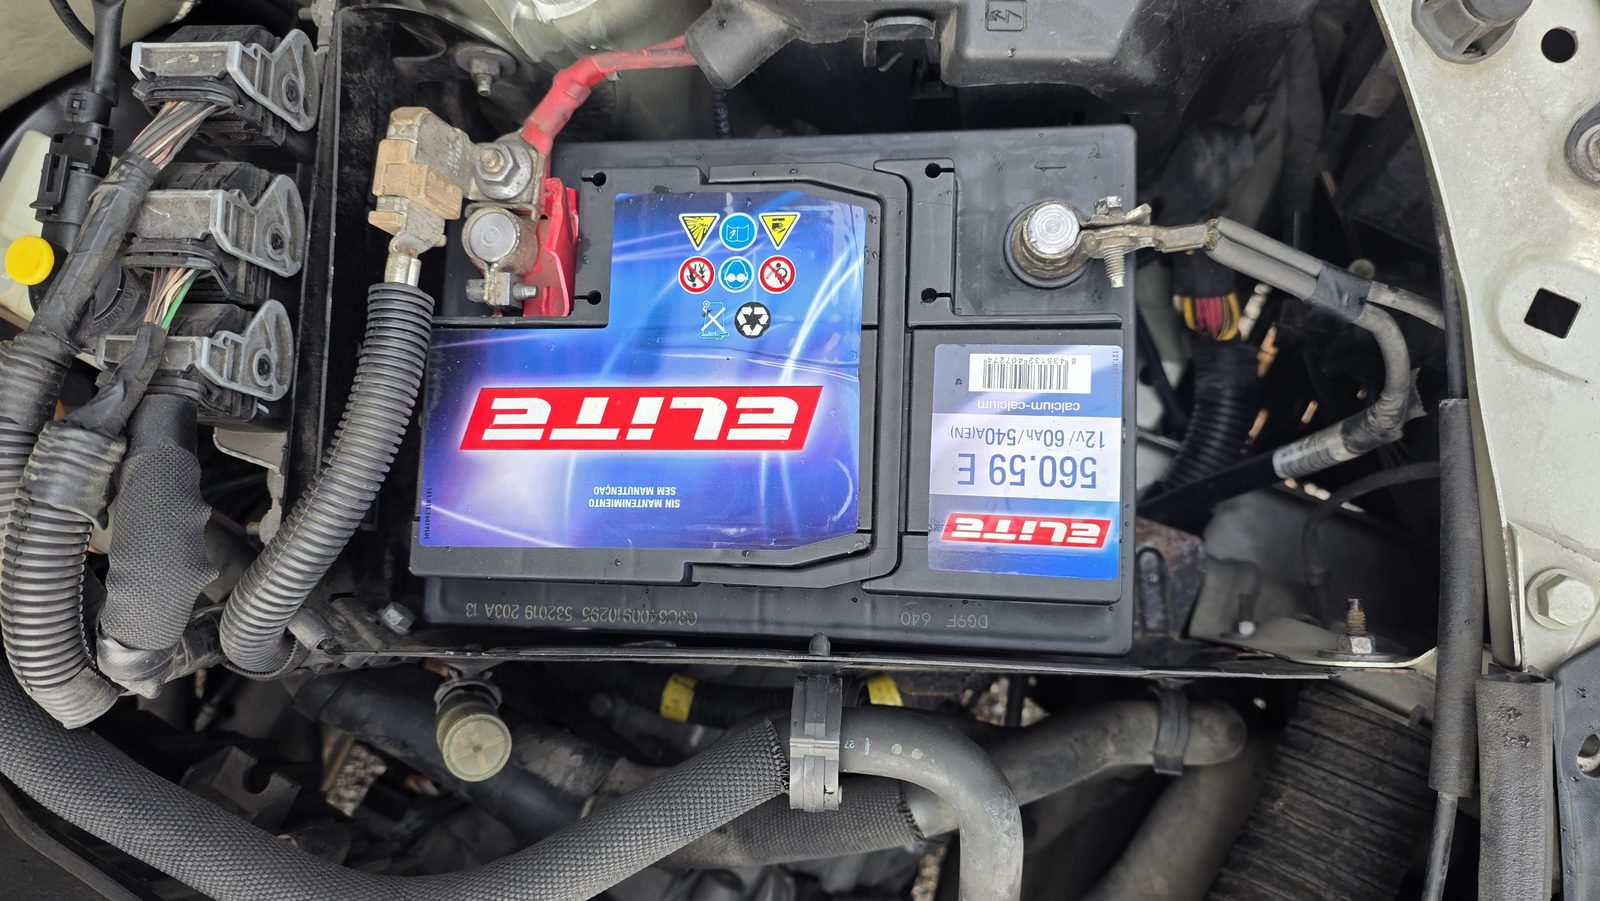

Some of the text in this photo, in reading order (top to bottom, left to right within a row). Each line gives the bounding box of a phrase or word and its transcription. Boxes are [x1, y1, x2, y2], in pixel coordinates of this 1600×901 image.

[987, 356, 1024, 364] 407274
[1028, 357, 1066, 365] 435132
[977, 400, 1080, 412] calcium-calcium
[957, 453, 1097, 489] 560.59 E
[657, 486, 676, 495] SEM
[588, 498, 680, 508] SIN MANTENIMIENTO
[465, 603, 477, 617] 13
[485, 603, 519, 619] 203A
[524, 605, 573, 622] 532019
[900, 611, 931, 626] 640
